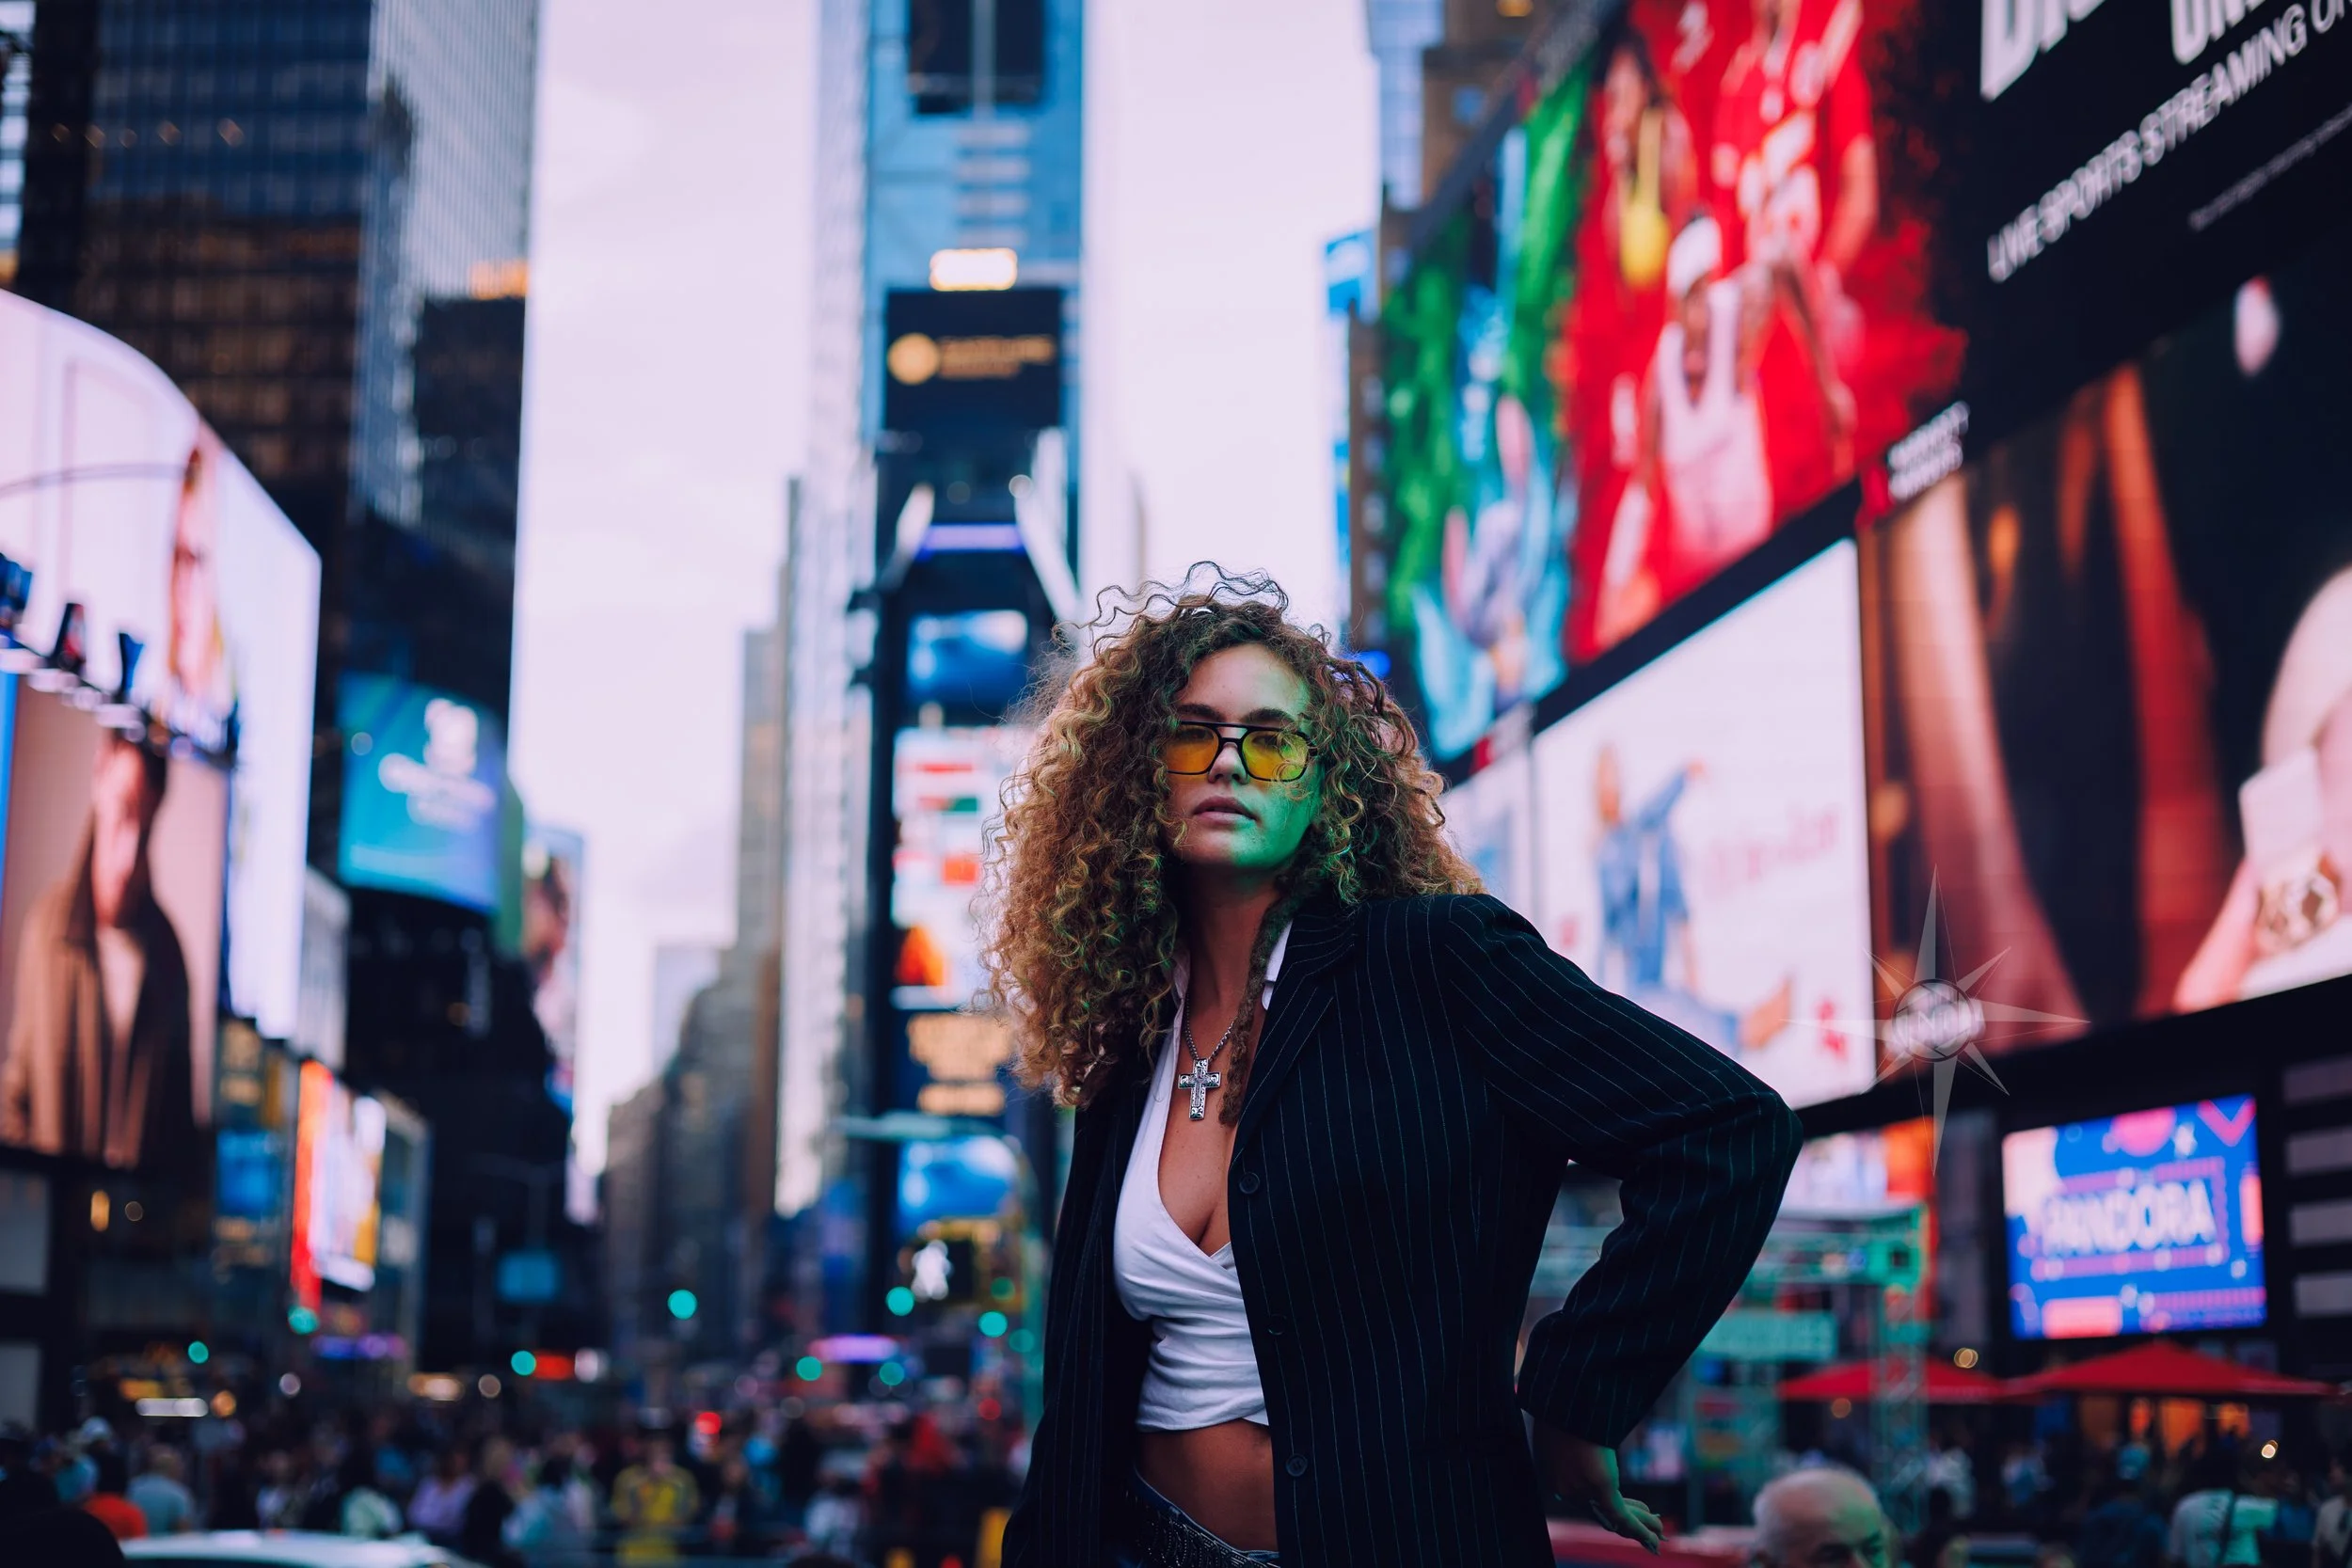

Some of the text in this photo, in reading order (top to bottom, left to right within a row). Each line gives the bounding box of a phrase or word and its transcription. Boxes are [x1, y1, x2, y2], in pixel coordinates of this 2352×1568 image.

[1987, 204, 2044, 282] LIVE
[2038, 130, 2141, 242] SPORTS
[2139, 4, 2308, 166] STREAMING
